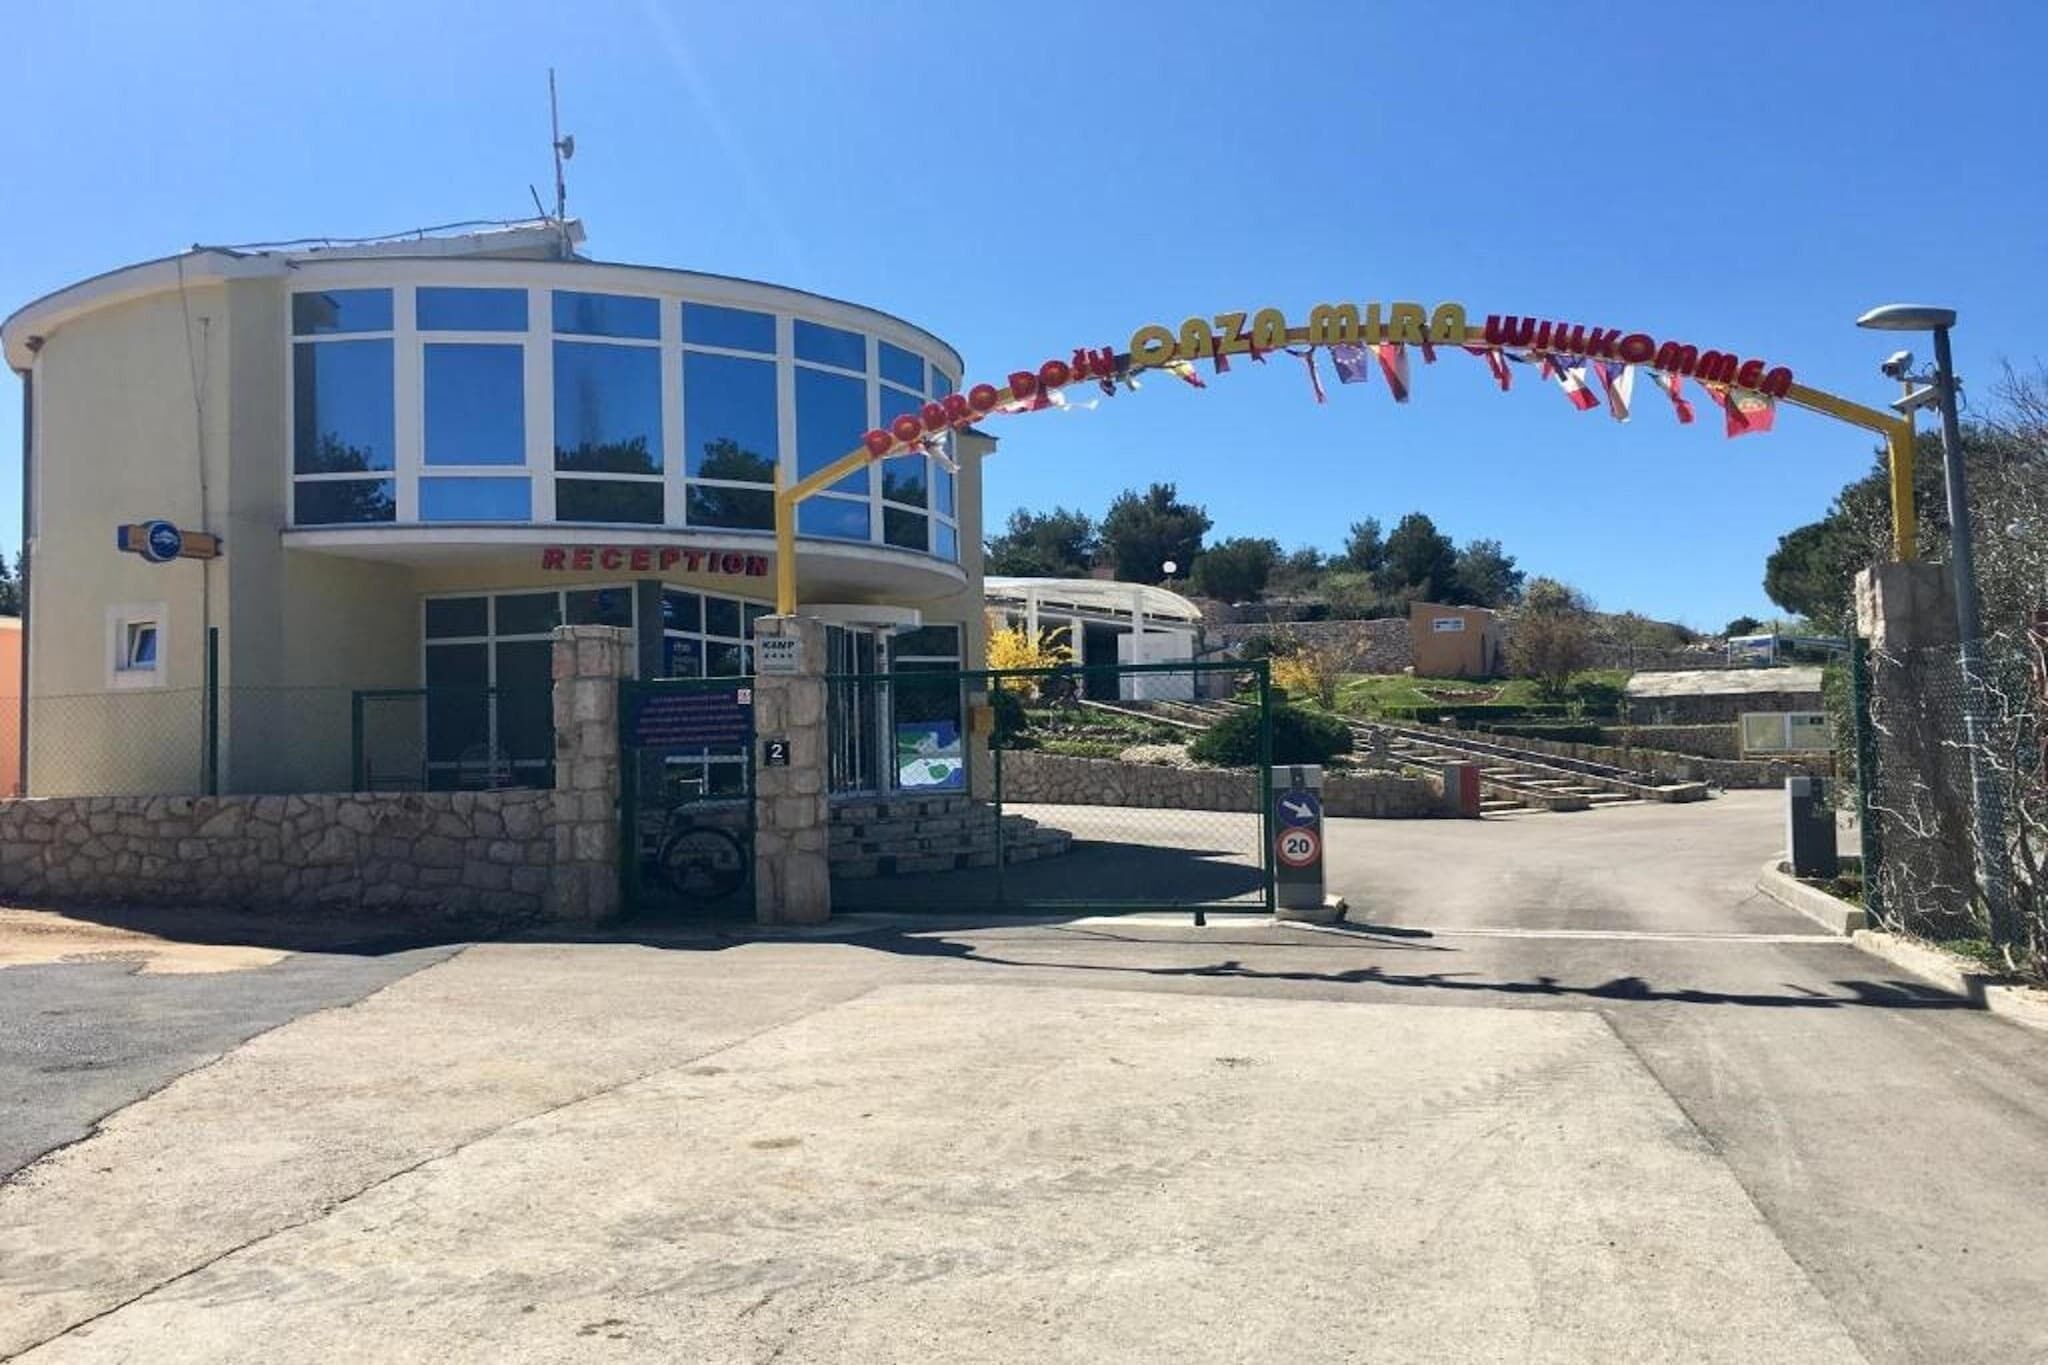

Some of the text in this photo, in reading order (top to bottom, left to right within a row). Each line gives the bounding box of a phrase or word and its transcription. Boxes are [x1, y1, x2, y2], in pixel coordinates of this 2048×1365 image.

[1129, 302, 1466, 368] OAZA MIRA
[542, 548, 769, 576] RECEPTION
[771, 743, 784, 759] 2
[1287, 838, 1310, 854] 20
